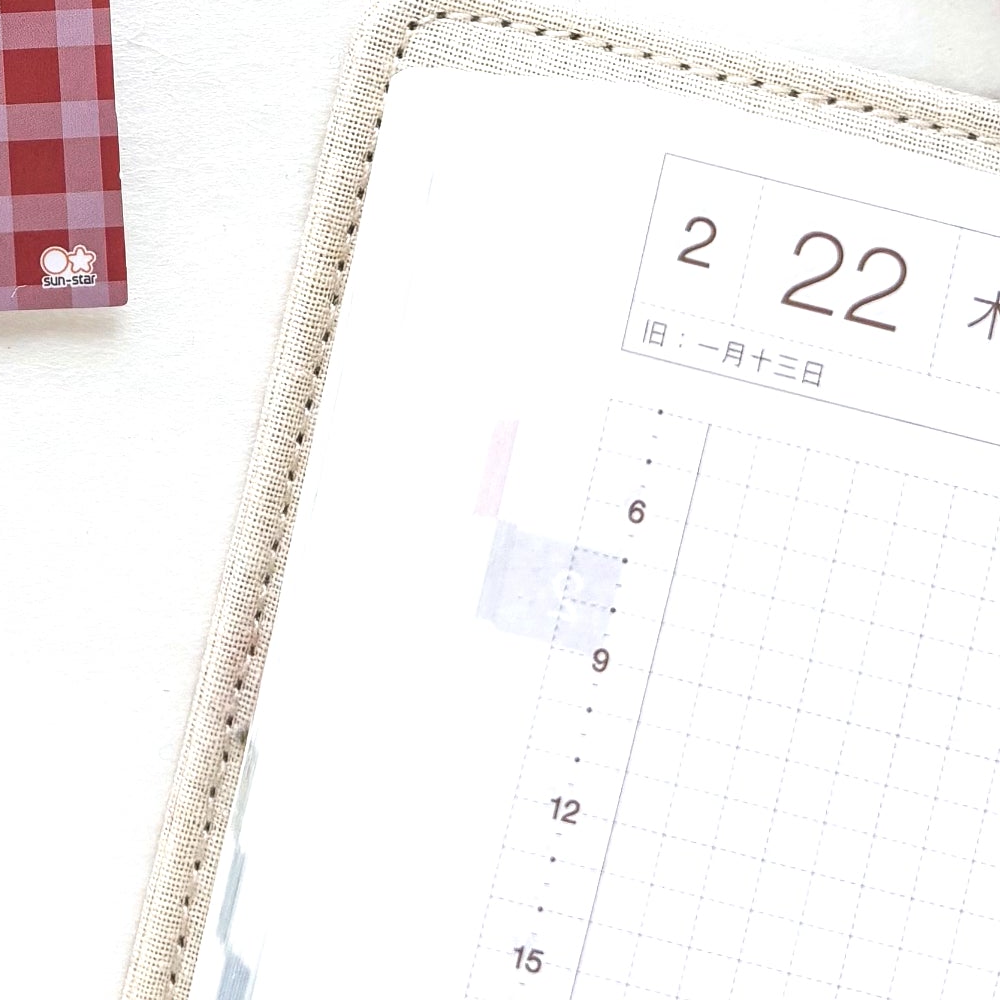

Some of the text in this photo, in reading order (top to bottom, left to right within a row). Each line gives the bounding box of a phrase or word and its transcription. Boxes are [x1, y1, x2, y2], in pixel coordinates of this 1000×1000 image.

[43, 274, 96, 287] sun-star
[677, 215, 908, 332] 2 22
[627, 499, 647, 524] 6
[591, 648, 611, 673] 9
[549, 796, 581, 825] 12
[513, 946, 545, 974] 15
